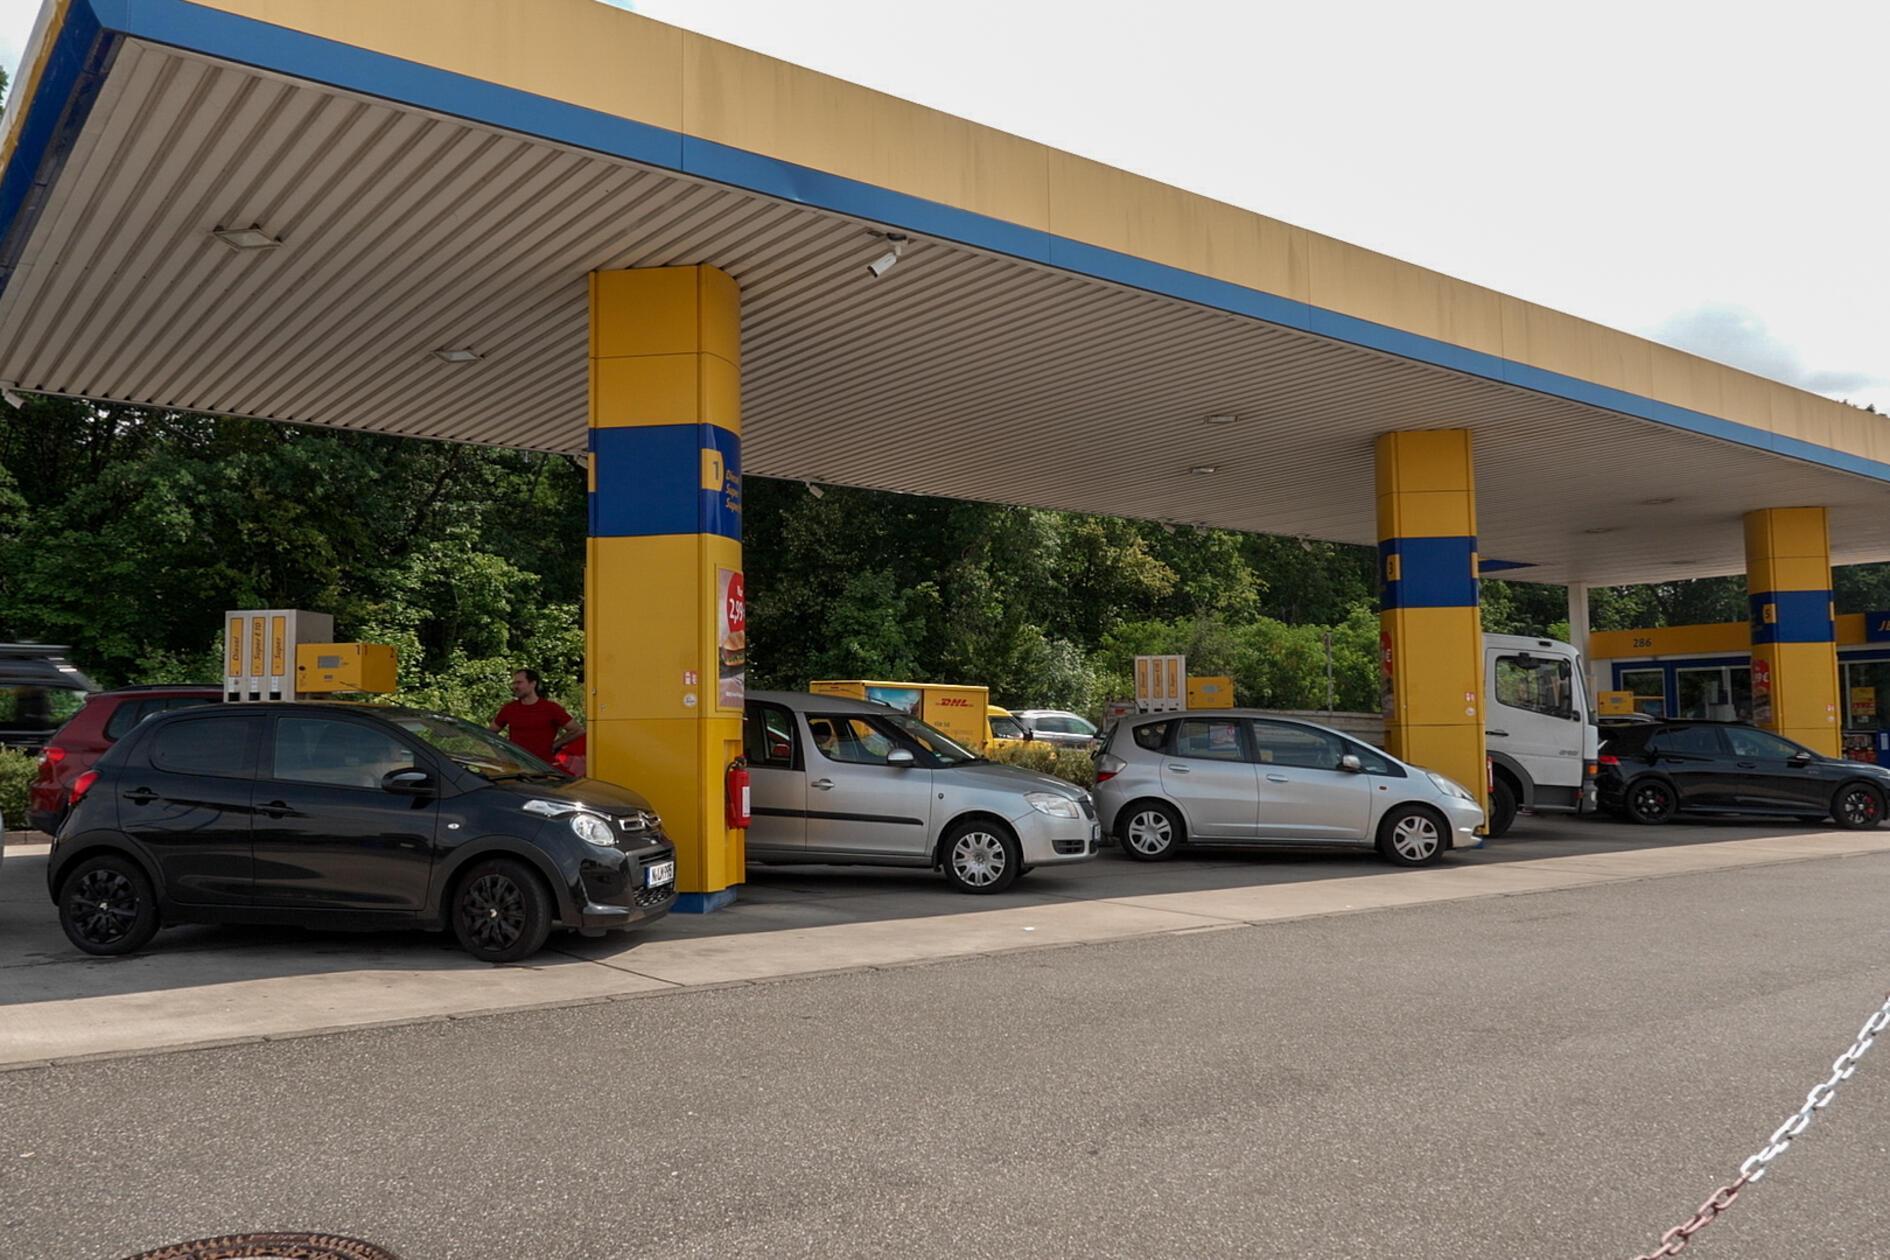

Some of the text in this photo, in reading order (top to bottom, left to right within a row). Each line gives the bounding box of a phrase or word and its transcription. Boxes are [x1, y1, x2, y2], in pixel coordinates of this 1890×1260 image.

[713, 461, 719, 480] 1
[273, 637, 283, 659] Super
[1632, 638, 1652, 648] 286
[939, 698, 970, 707] DHL
